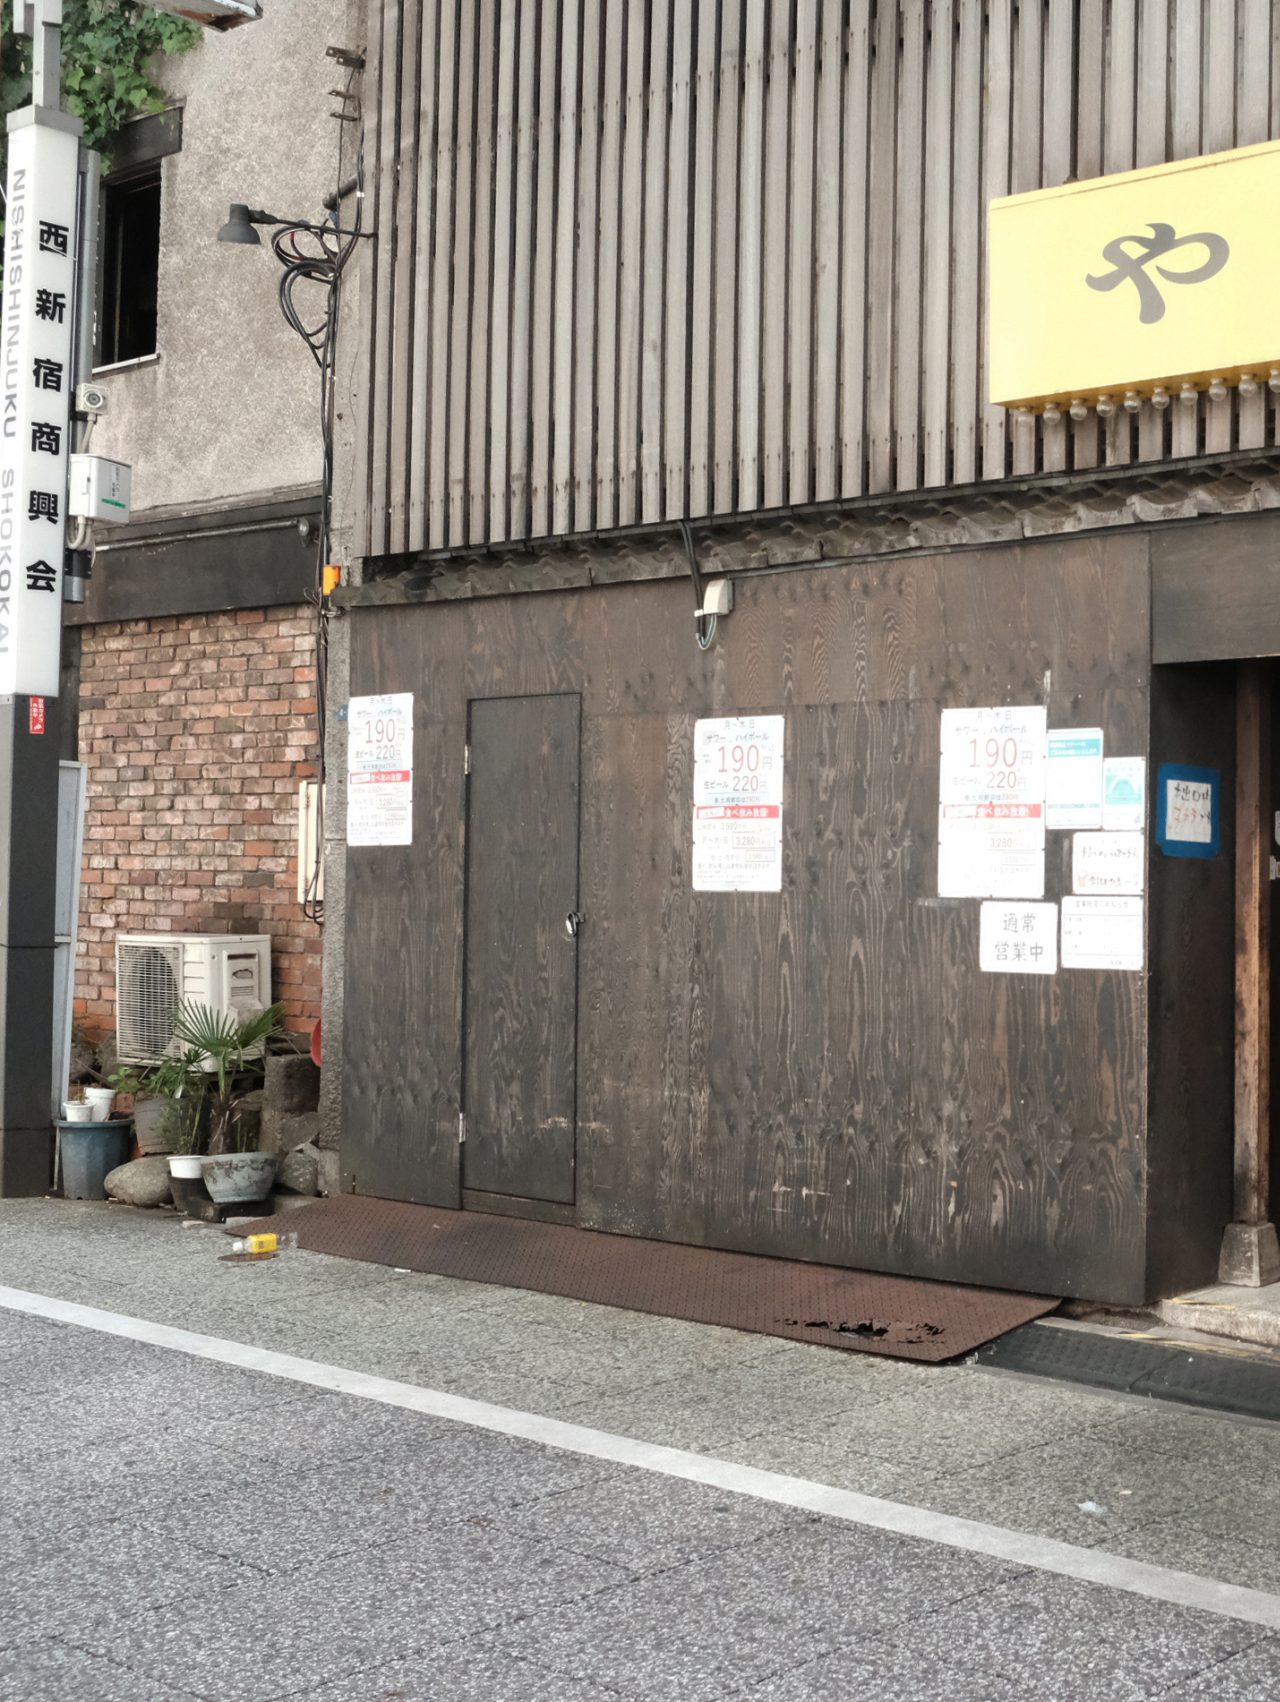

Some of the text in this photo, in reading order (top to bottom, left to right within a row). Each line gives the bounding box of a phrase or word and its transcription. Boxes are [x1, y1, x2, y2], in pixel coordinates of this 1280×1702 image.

[3, 168, 26, 438] NISHISHINJUKU
[26, 220, 69, 593] 西新宿商興会
[995, 942, 1043, 962] 営業中
[1003, 912, 1036, 933] 通常
